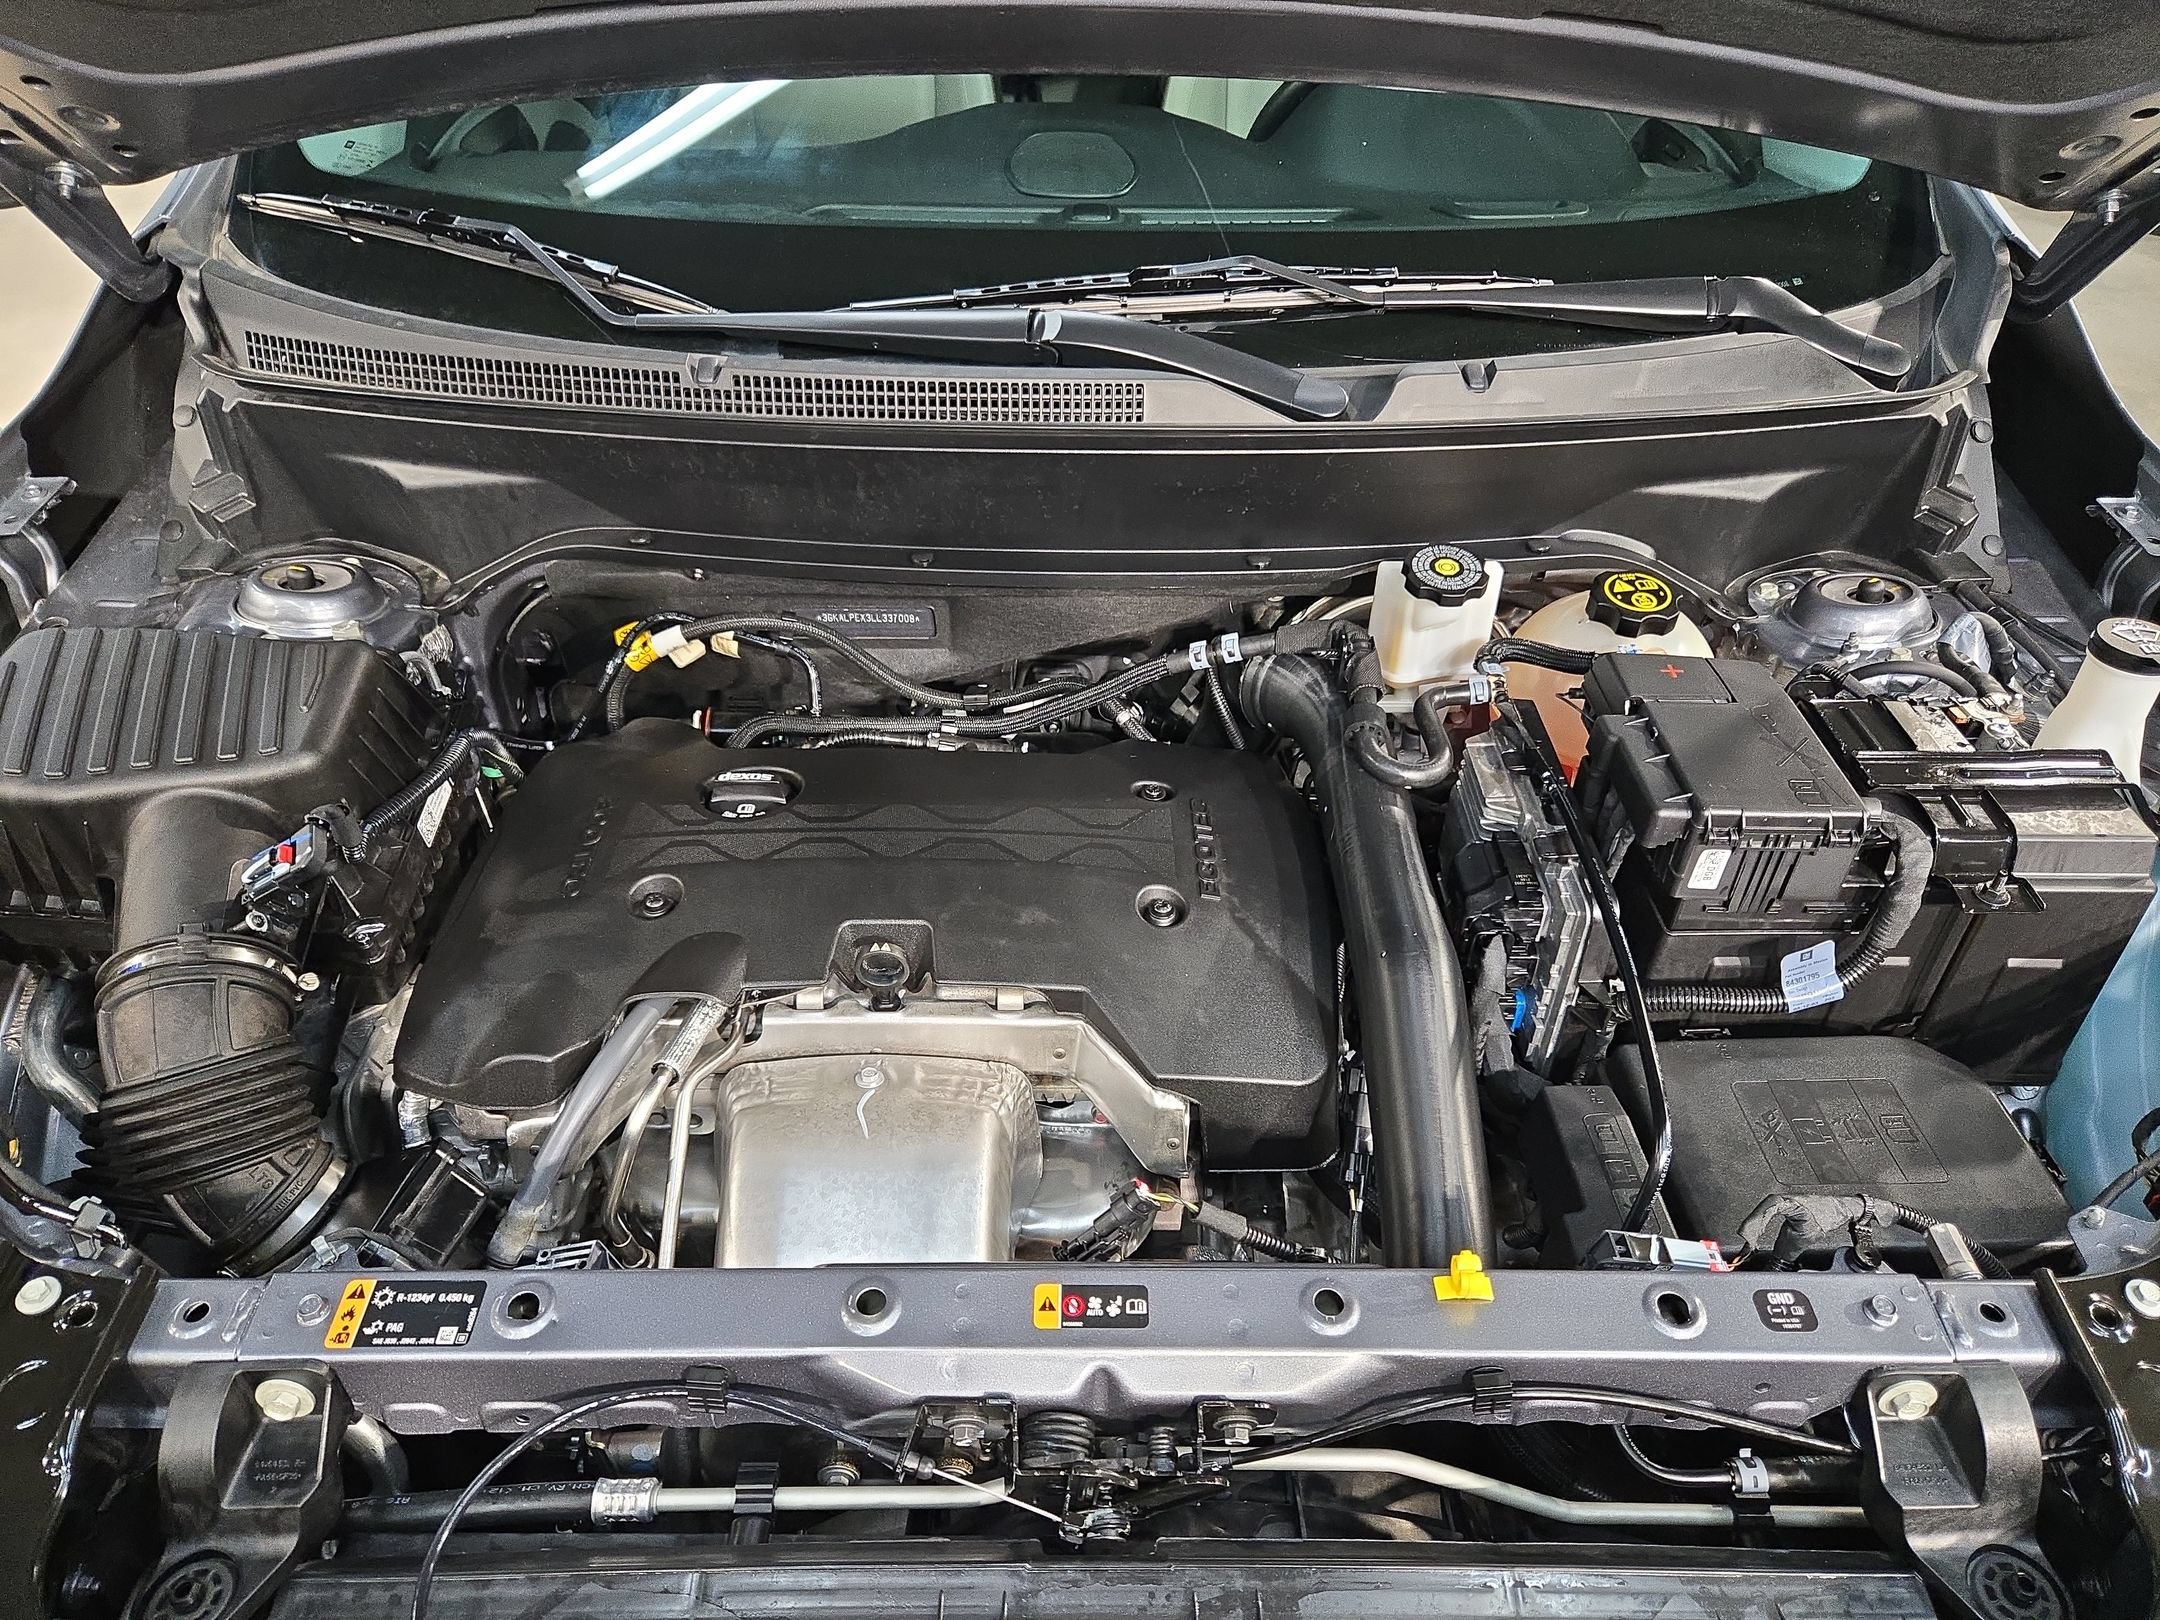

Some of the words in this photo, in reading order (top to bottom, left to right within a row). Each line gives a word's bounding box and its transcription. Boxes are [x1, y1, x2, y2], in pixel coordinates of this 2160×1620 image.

[717, 771, 775, 782] dexos
[1190, 798, 1221, 901] ECOTEC
[1785, 972, 1821, 987] 84301795
[397, 1293, 435, 1304] R-1234yf
[438, 1293, 463, 1303] 0.450
[462, 1293, 475, 1304] kg
[1766, 1292, 1795, 1305] GND
[1086, 1308, 1104, 1317] AUTO
[385, 1322, 405, 1333] PAG
